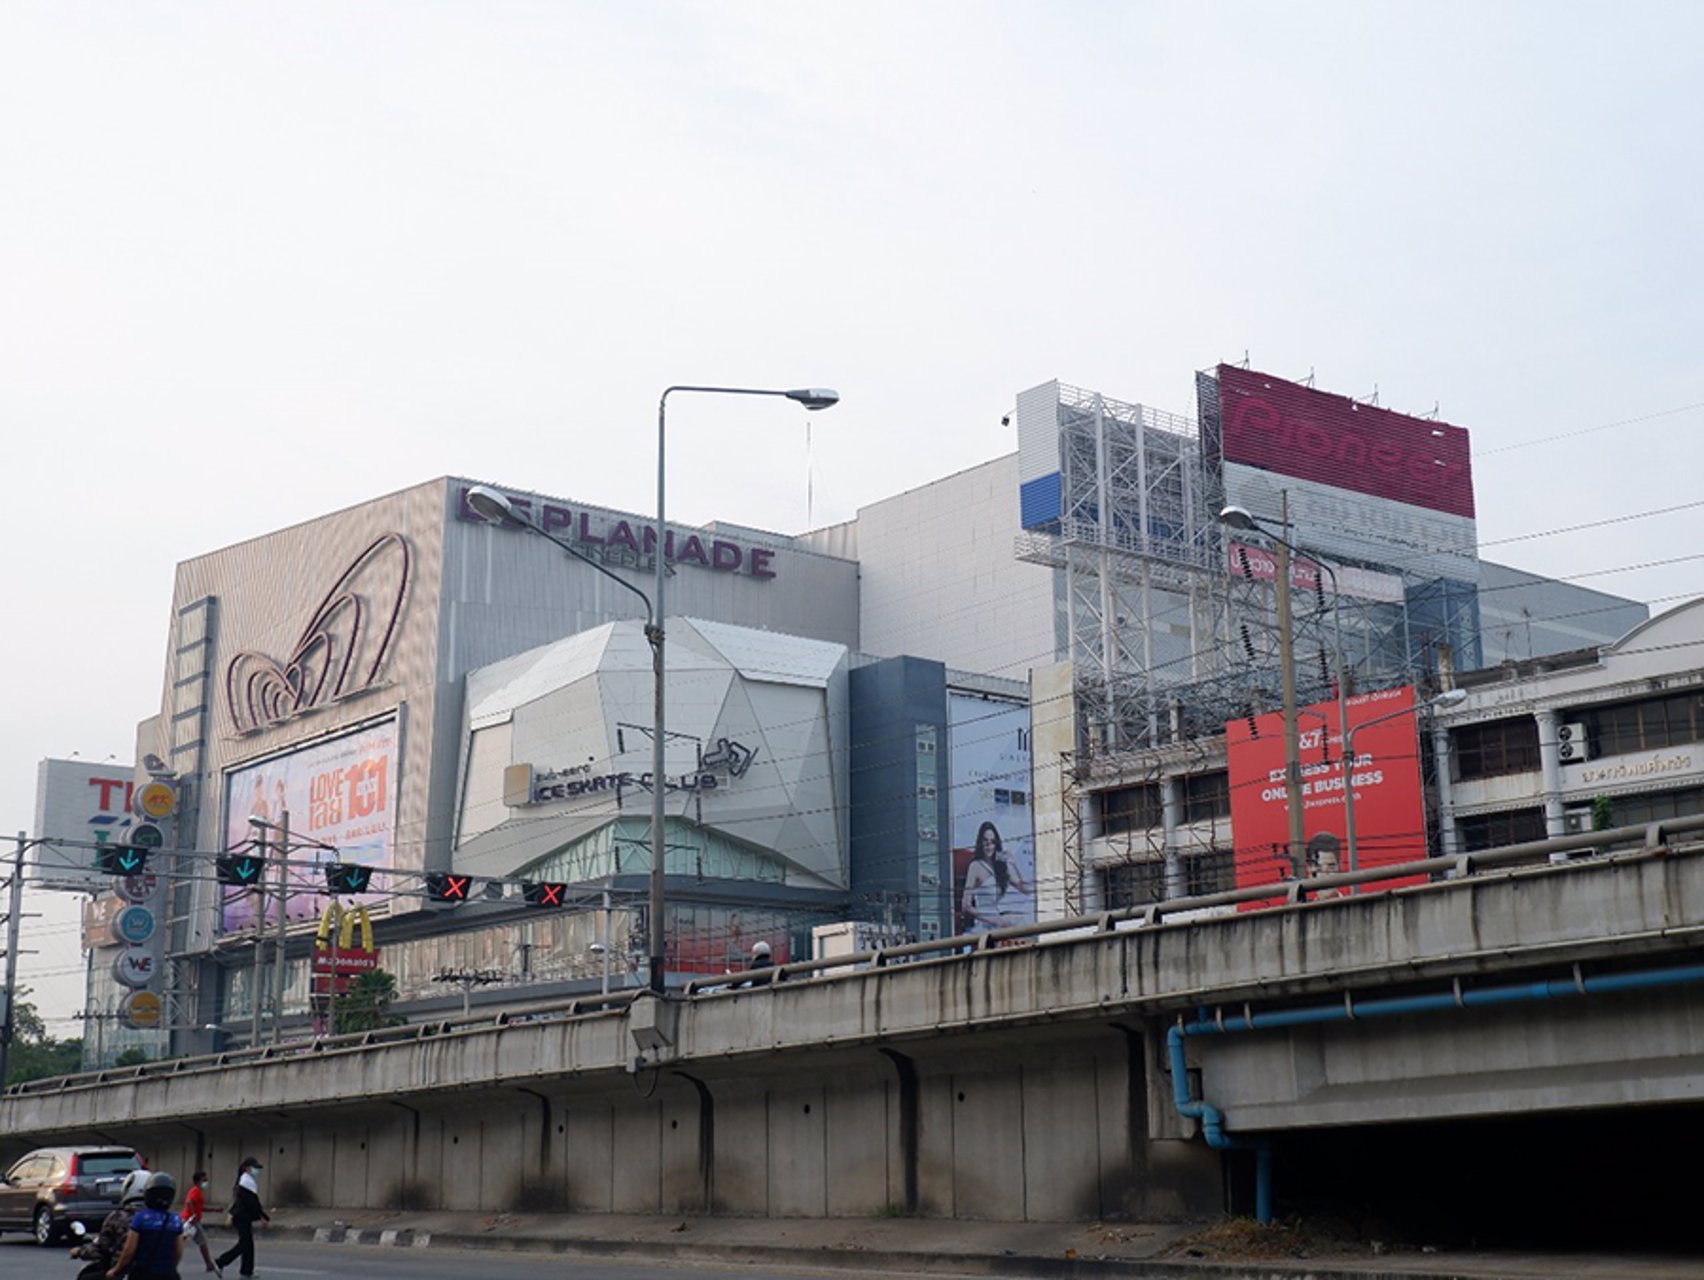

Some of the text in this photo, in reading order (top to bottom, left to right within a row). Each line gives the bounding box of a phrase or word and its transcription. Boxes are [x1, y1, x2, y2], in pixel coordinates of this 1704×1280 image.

[309, 755, 388, 820] LOVE 101
[1261, 783, 1312, 801] ONLE
